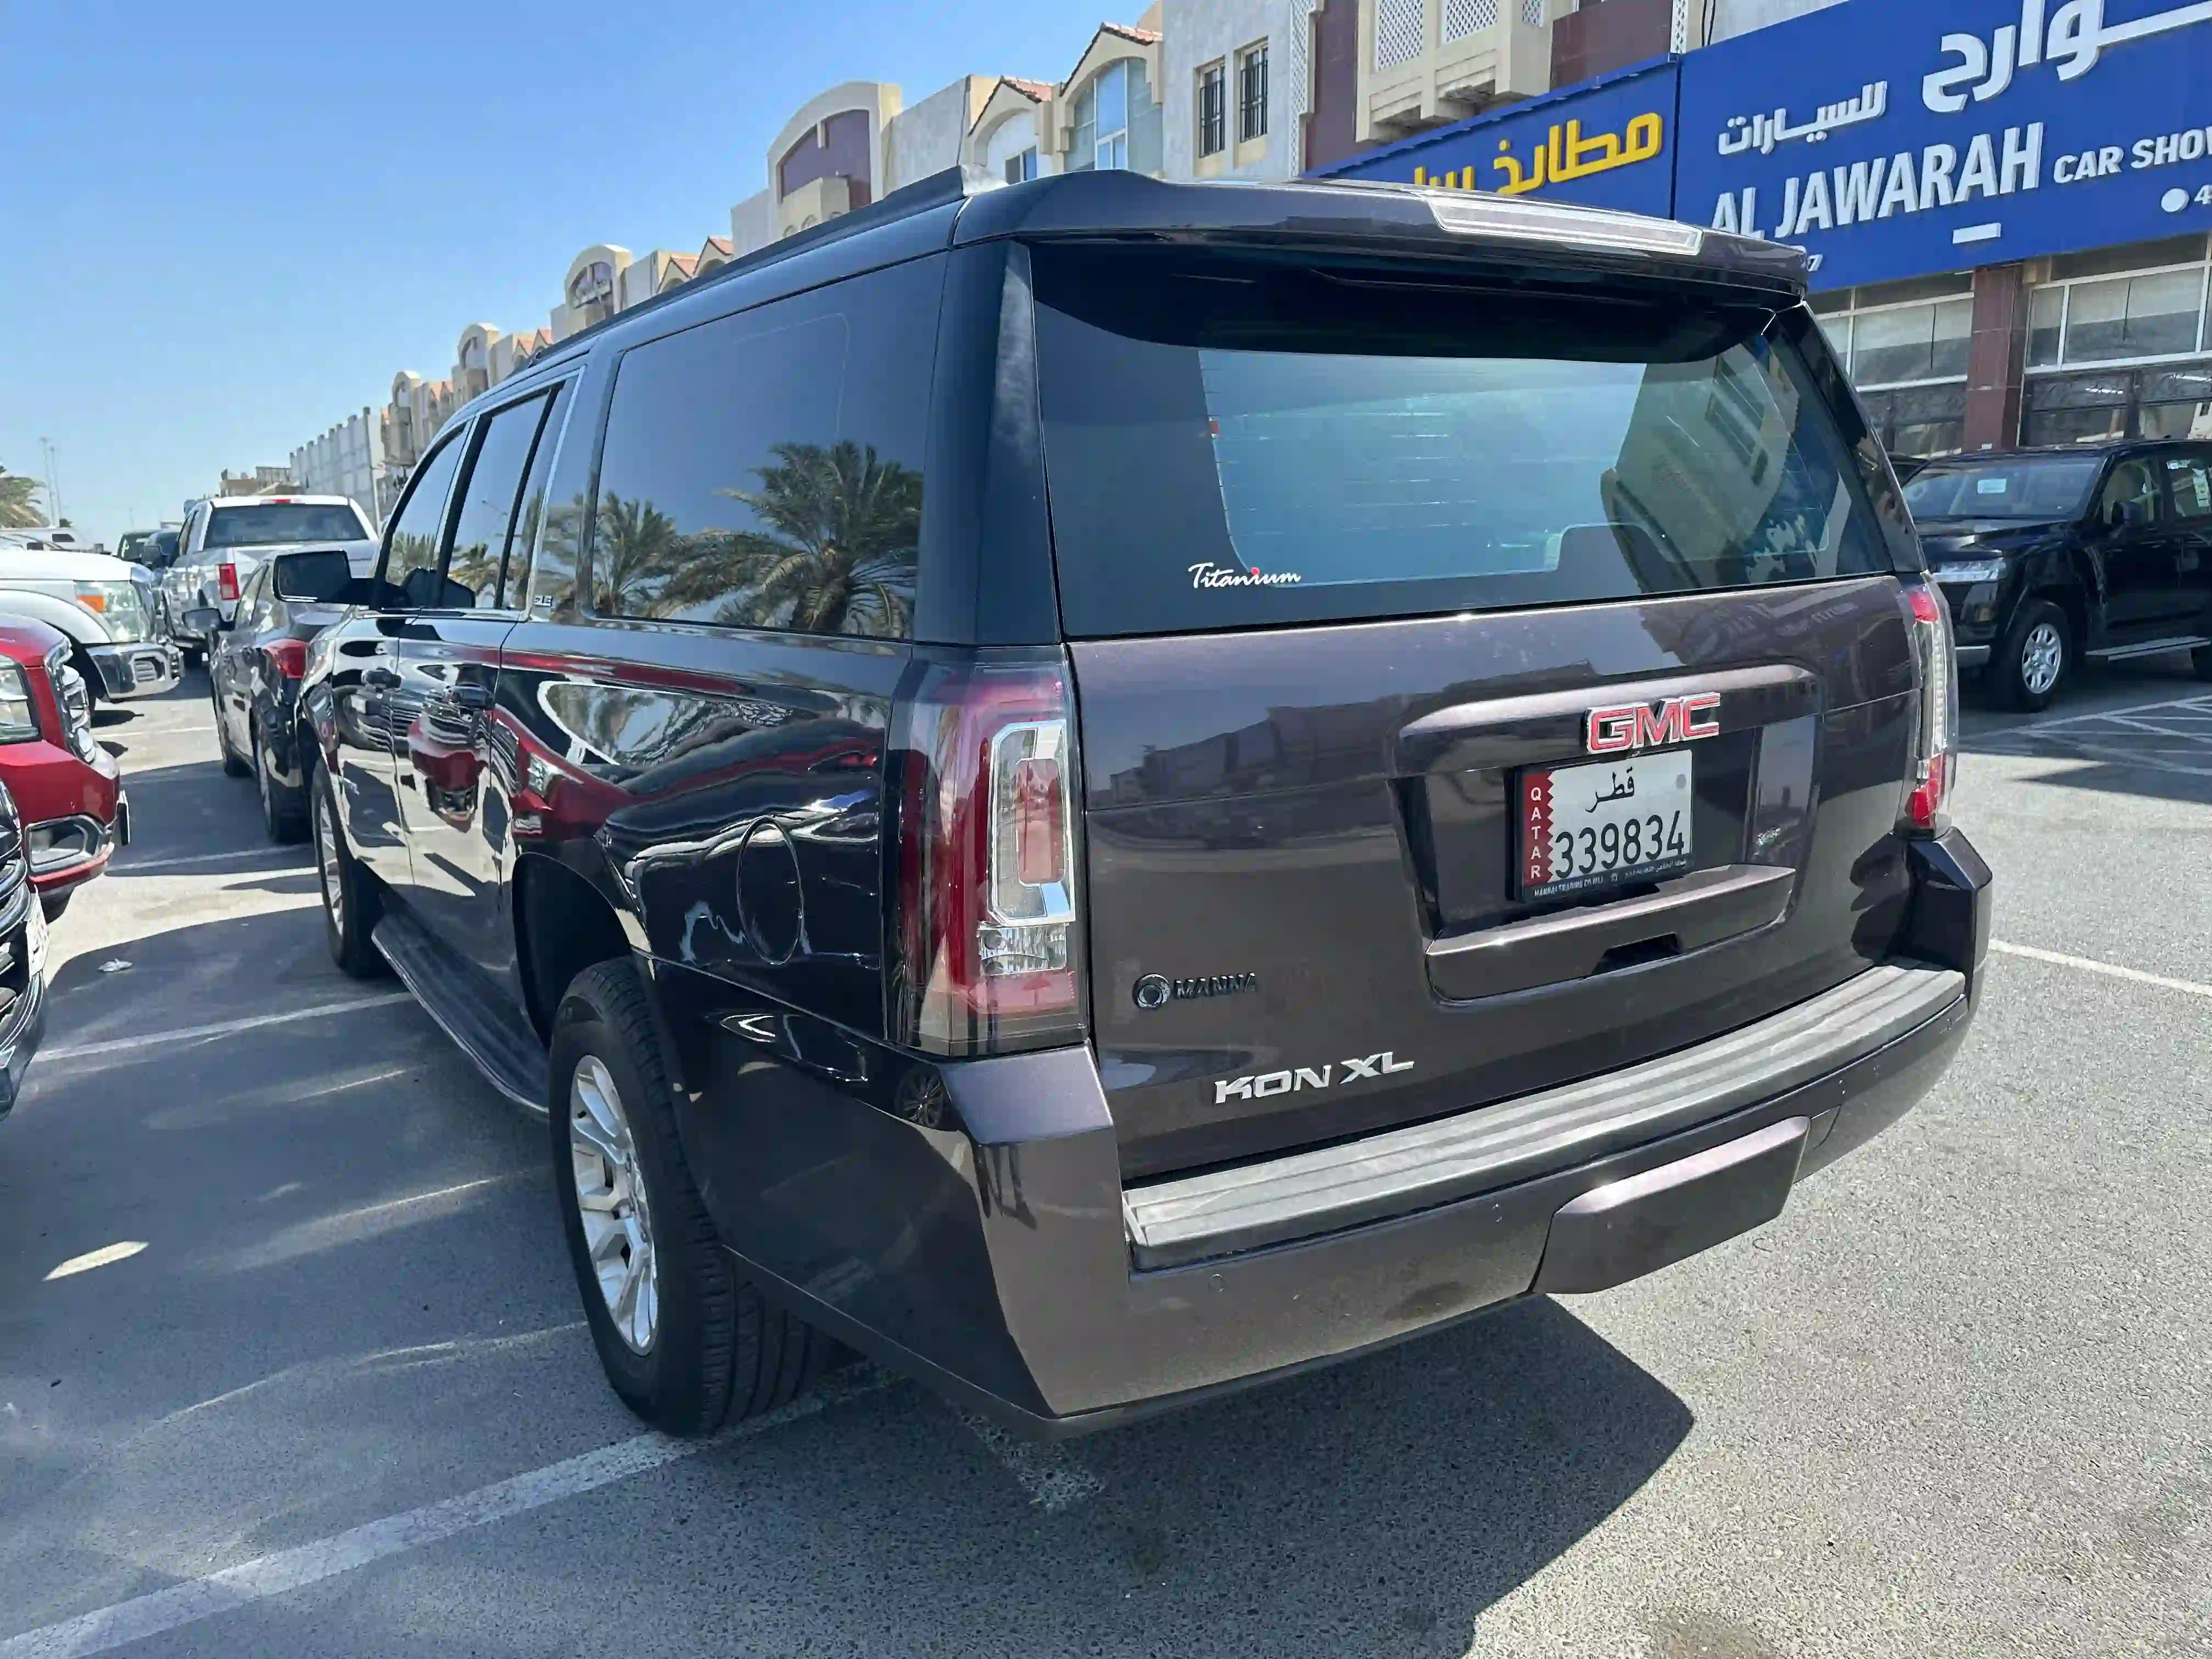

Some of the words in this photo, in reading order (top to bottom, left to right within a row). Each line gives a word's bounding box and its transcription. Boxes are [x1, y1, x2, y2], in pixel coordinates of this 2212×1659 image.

[1718, 80, 1887, 155] للسيارات
[1711, 187, 1765, 240] AL
[1774, 121, 2044, 238] JAWARAH
[2053, 146, 2124, 184] CAR
[1188, 562, 1301, 589] Titanium
[1585, 692, 1721, 755] GMC
[1584, 766, 1635, 813] قطر
[1530, 786, 1542, 880] QATAR
[1555, 810, 1684, 879] 339834
[1214, 1064, 1332, 1104] KON
[1339, 1051, 1415, 1085] XL
